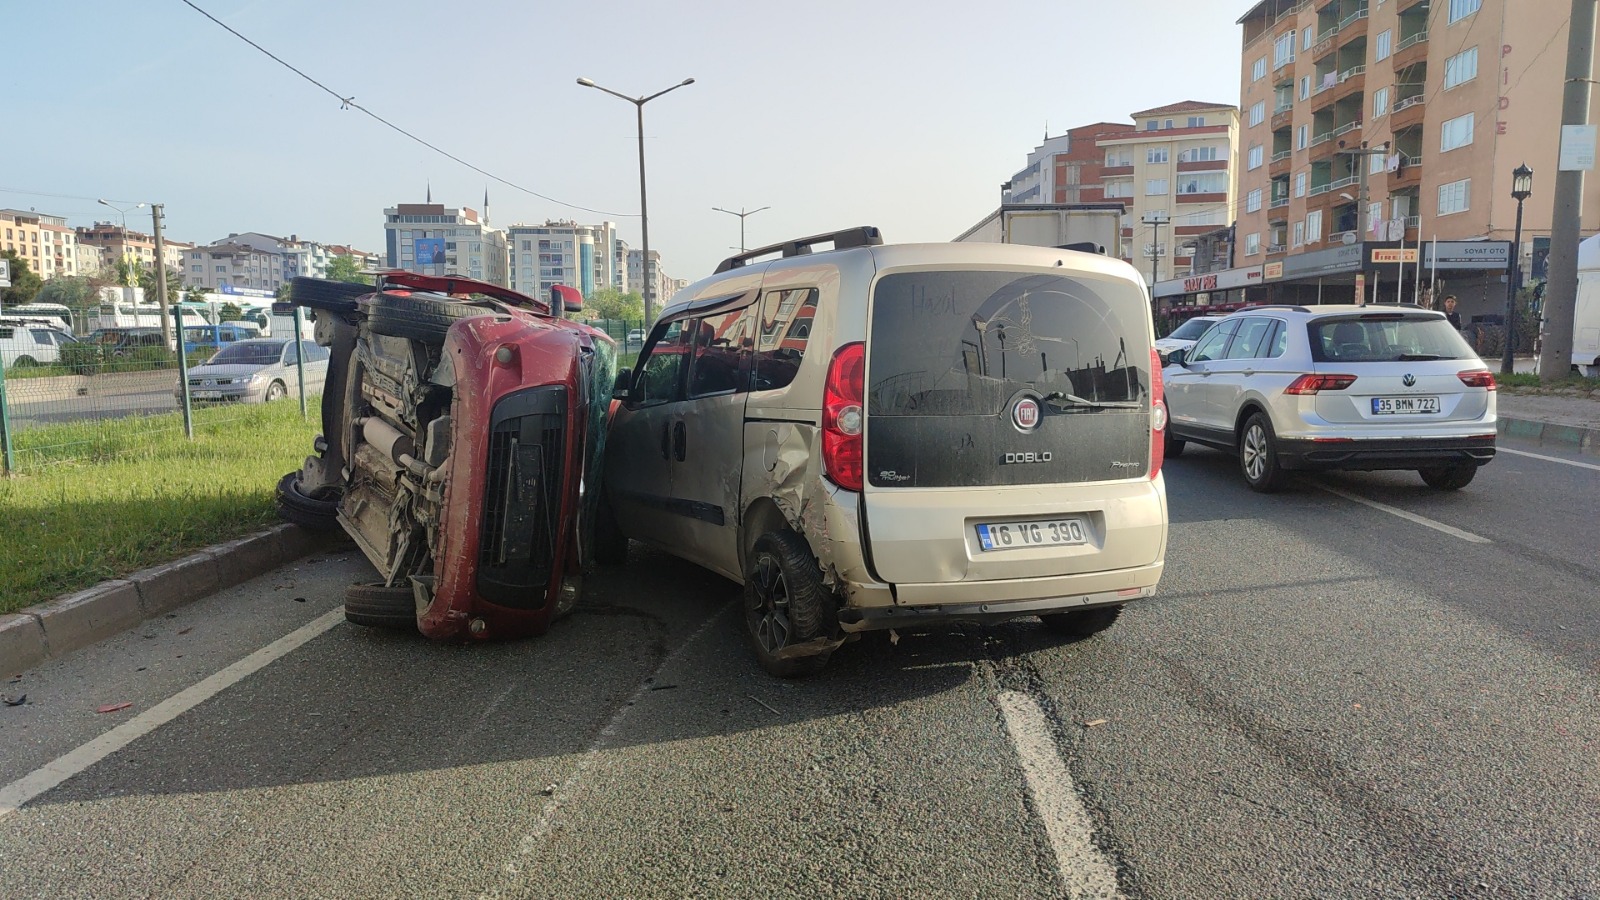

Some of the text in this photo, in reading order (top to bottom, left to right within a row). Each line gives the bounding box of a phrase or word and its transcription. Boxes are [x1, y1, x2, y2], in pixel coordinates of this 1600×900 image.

[1380, 398, 1435, 411] 35 BMN 722
[1020, 407, 1036, 421] FIAT
[1005, 451, 1052, 464] DOBLO
[990, 521, 1083, 546] 16 VG 390
